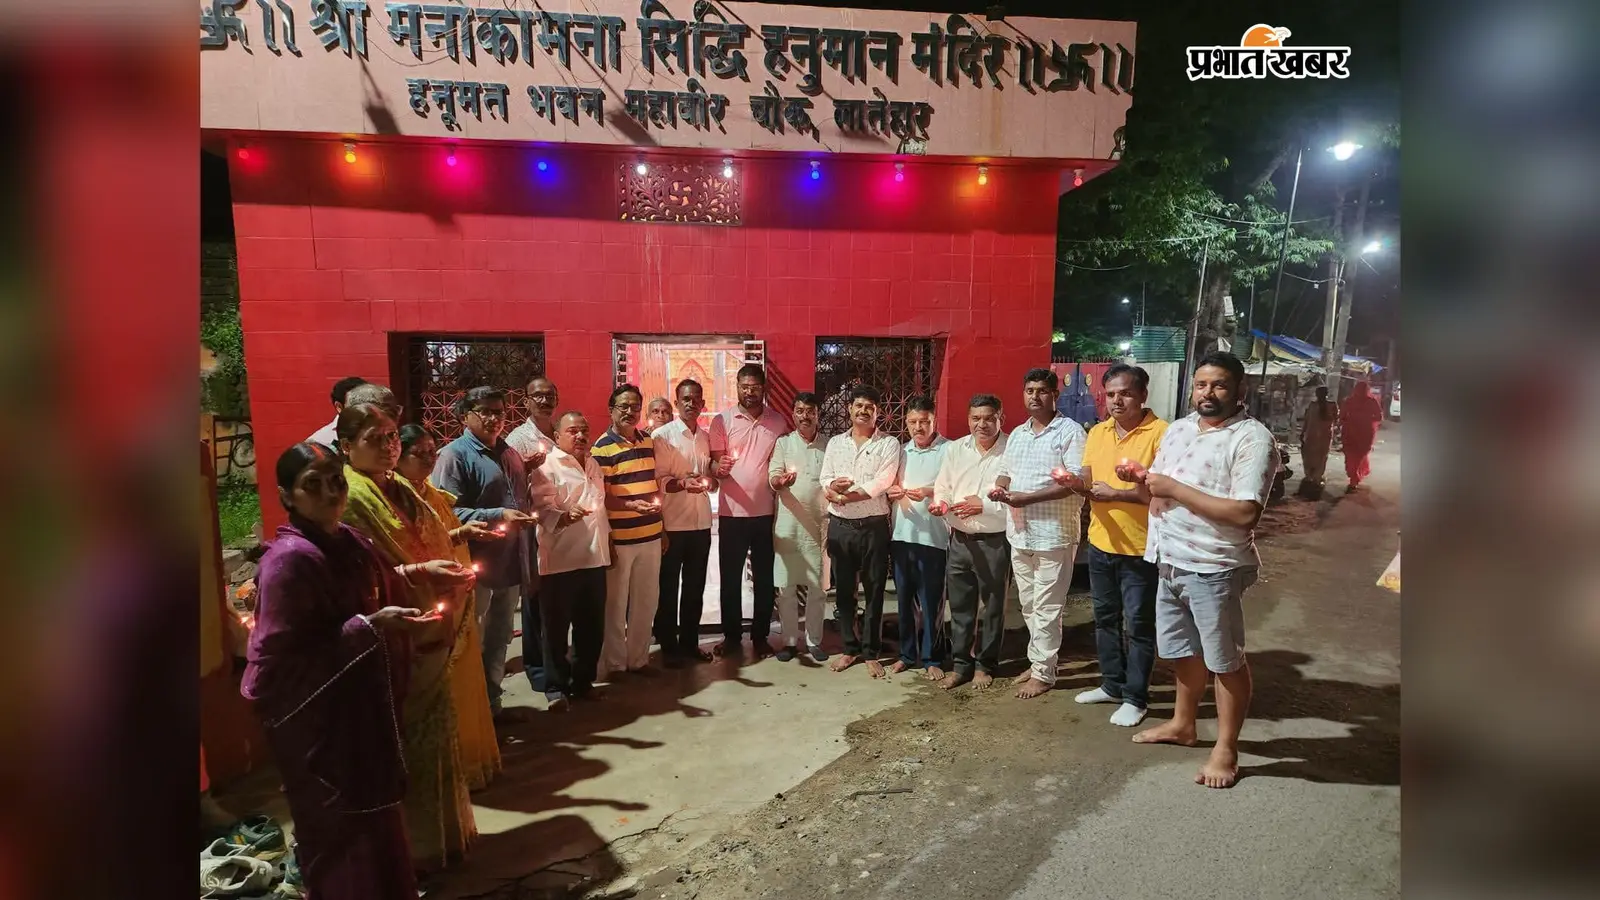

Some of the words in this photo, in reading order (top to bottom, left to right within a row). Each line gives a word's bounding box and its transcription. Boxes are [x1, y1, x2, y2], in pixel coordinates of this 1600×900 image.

[636, 0, 751, 83] सिद्धि
[760, 24, 904, 97] हनुमान
[911, 14, 1010, 91] मंदिर
[527, 85, 606, 128] भवन
[624, 77, 730, 135] महावीर
[833, 87, 934, 140] लातेहार
